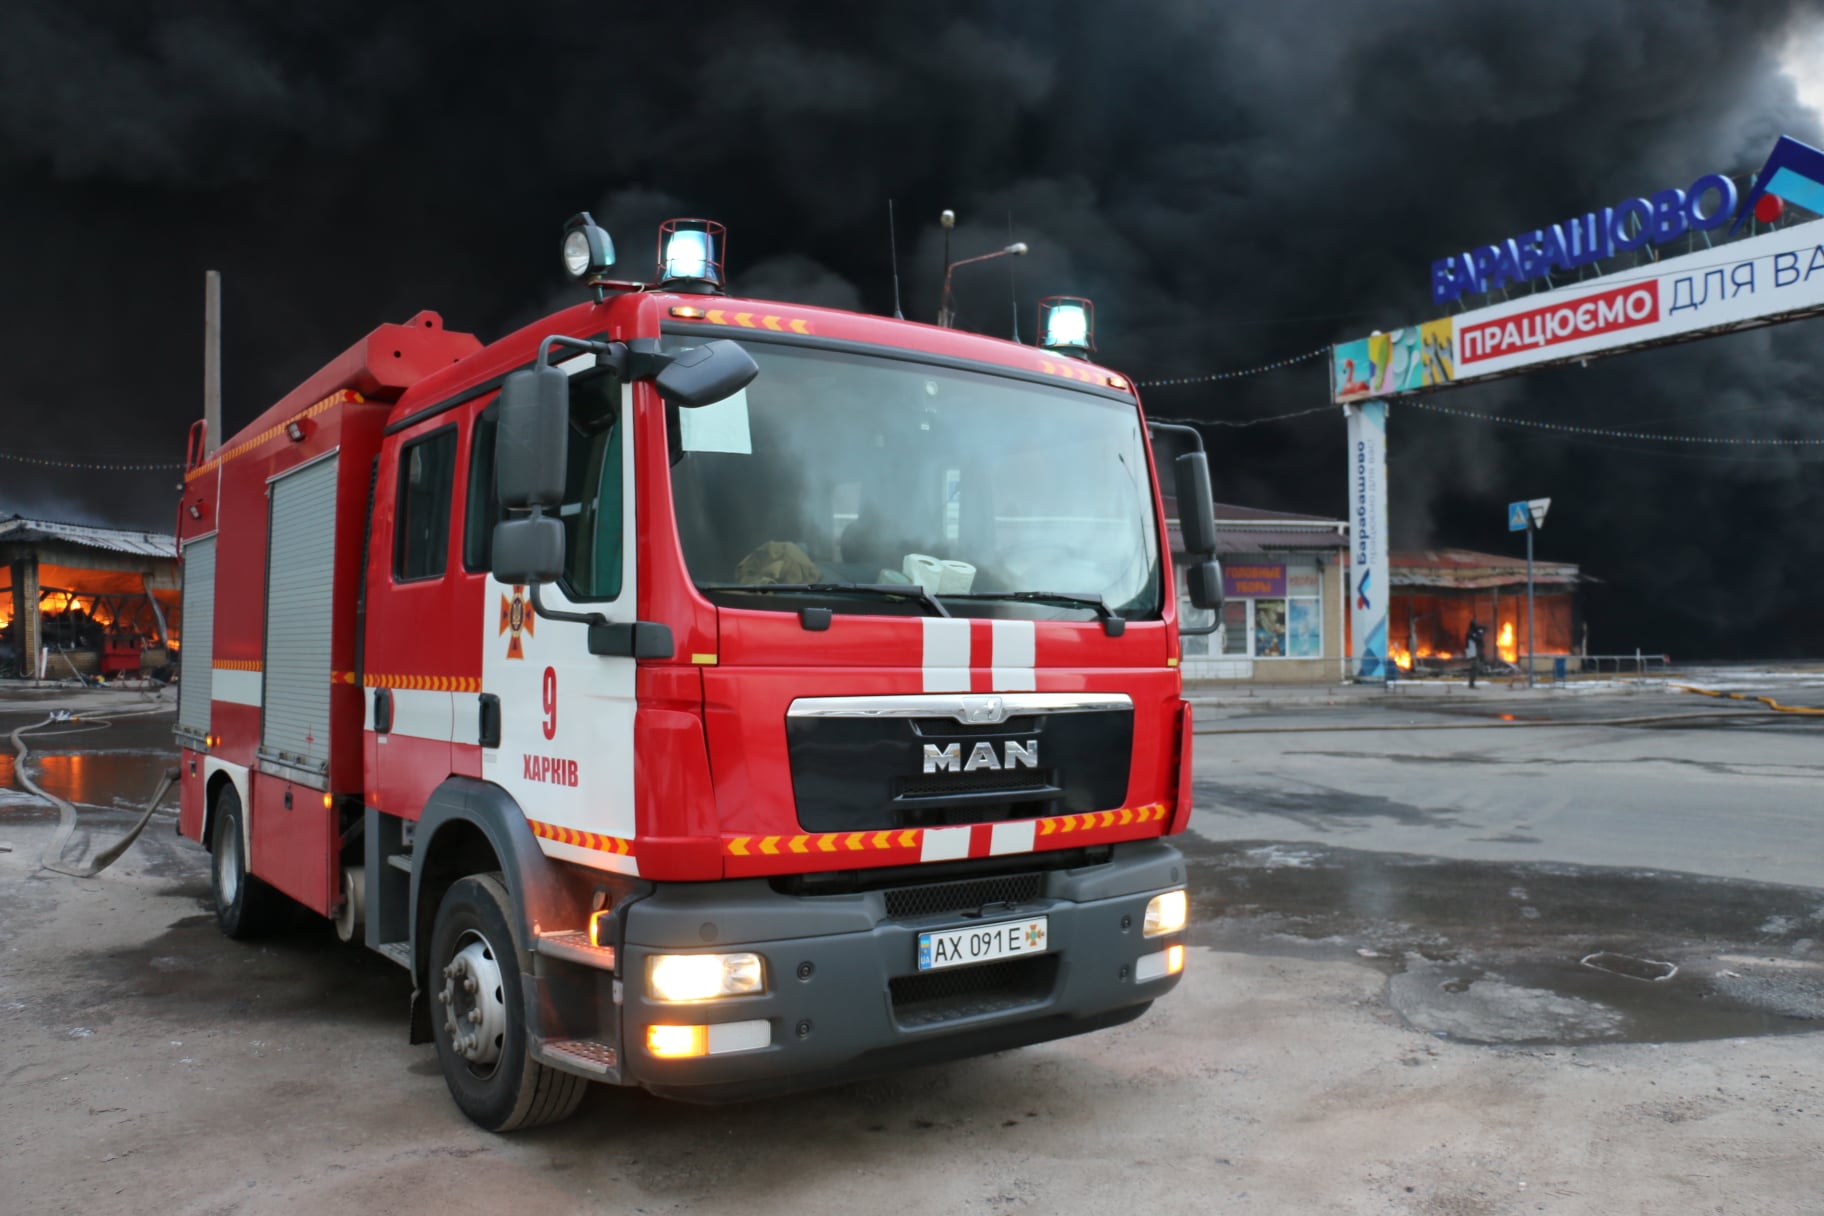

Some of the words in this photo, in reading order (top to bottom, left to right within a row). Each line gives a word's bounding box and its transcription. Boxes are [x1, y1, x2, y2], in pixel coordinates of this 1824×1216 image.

[1431, 174, 1737, 304] БАРАБАШОВО
[1463, 289, 1653, 359] ПРАЦЮЄМО
[1669, 261, 1755, 316] ДЛЯ
[1357, 441, 1369, 565] Барабашово
[542, 665, 557, 741] 9
[523, 753, 579, 788] ХАРКІВ
[922, 739, 1039, 774] MAN
[934, 936, 963, 963] AX
[970, 929, 1002, 957] 091
[1008, 926, 1021, 951] E
